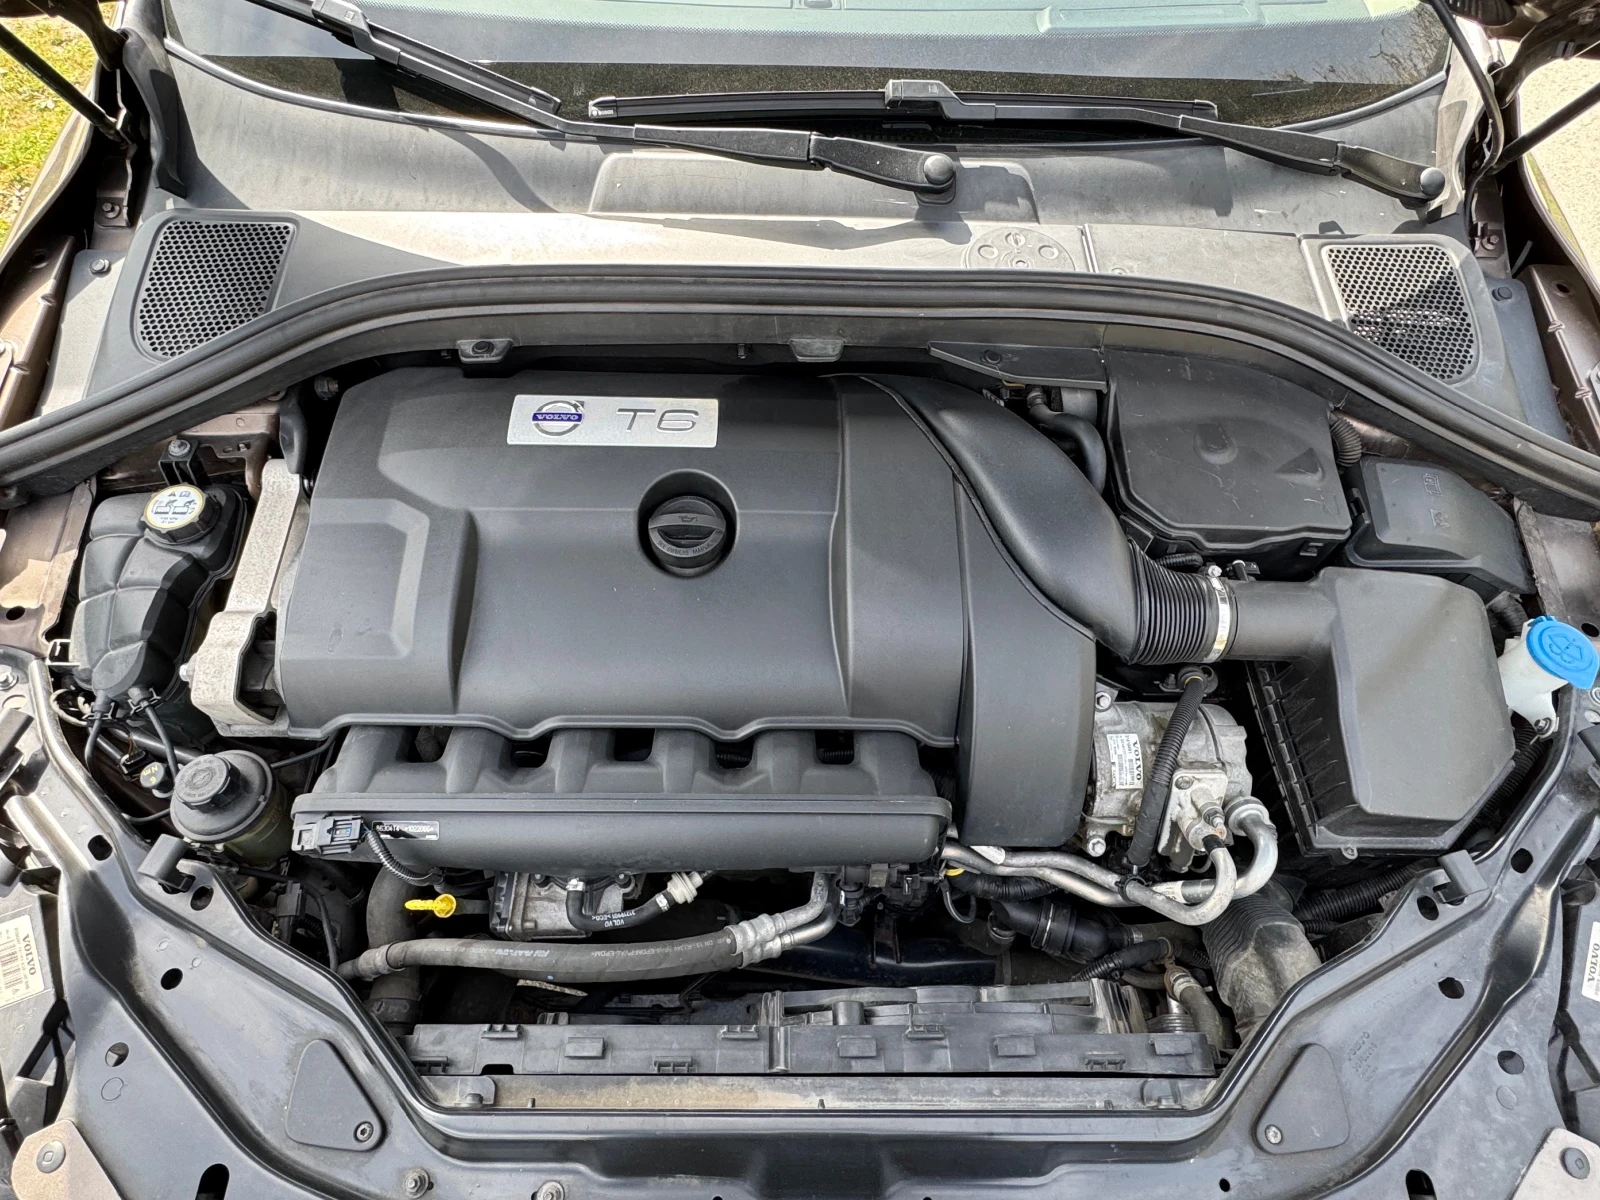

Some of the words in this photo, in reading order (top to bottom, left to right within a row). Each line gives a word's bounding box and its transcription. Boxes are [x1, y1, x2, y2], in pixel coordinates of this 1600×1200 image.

[536, 413, 579, 421] VOLVO
[616, 408, 699, 432] T6
[1132, 740, 1142, 780] VOLVO
[604, 918, 625, 928] VOLVO
[22, 933, 37, 976] VOLVO
[1587, 942, 1600, 983] VOLVO
